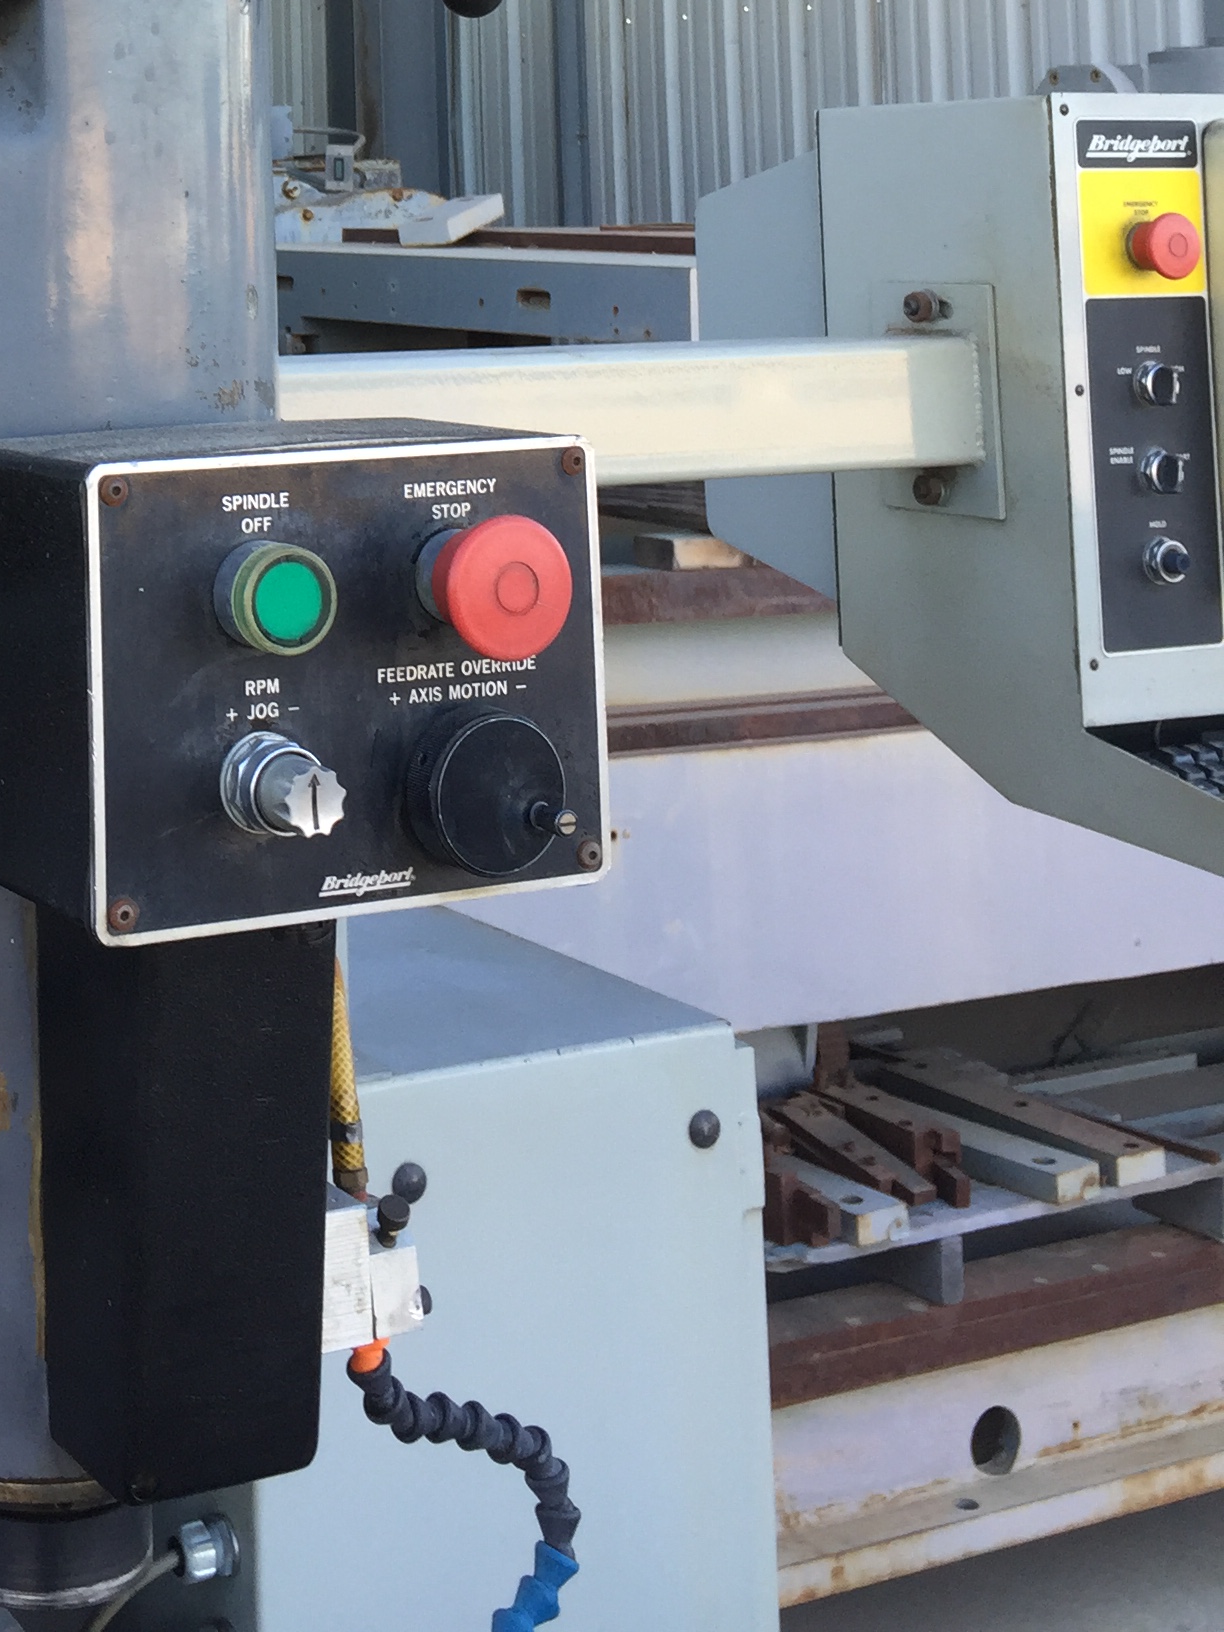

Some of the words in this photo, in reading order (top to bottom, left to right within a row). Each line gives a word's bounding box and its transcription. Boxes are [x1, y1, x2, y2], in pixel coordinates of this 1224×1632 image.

[1087, 134, 1189, 162] Bridgeport
[1117, 367, 1133, 375] LOW
[404, 478, 496, 499] EMERGENCY
[221, 492, 290, 512] SPINDLE
[431, 502, 471, 520] STOP
[241, 517, 272, 534] OFF
[377, 662, 455, 684] FEEDRATE
[461, 655, 536, 676] OVERRIDE
[245, 678, 280, 697] RPM
[408, 686, 443, 704] AXIS
[448, 681, 508, 701] MOTION
[246, 702, 279, 719] JOG
[320, 866, 414, 897] Bridgeport
